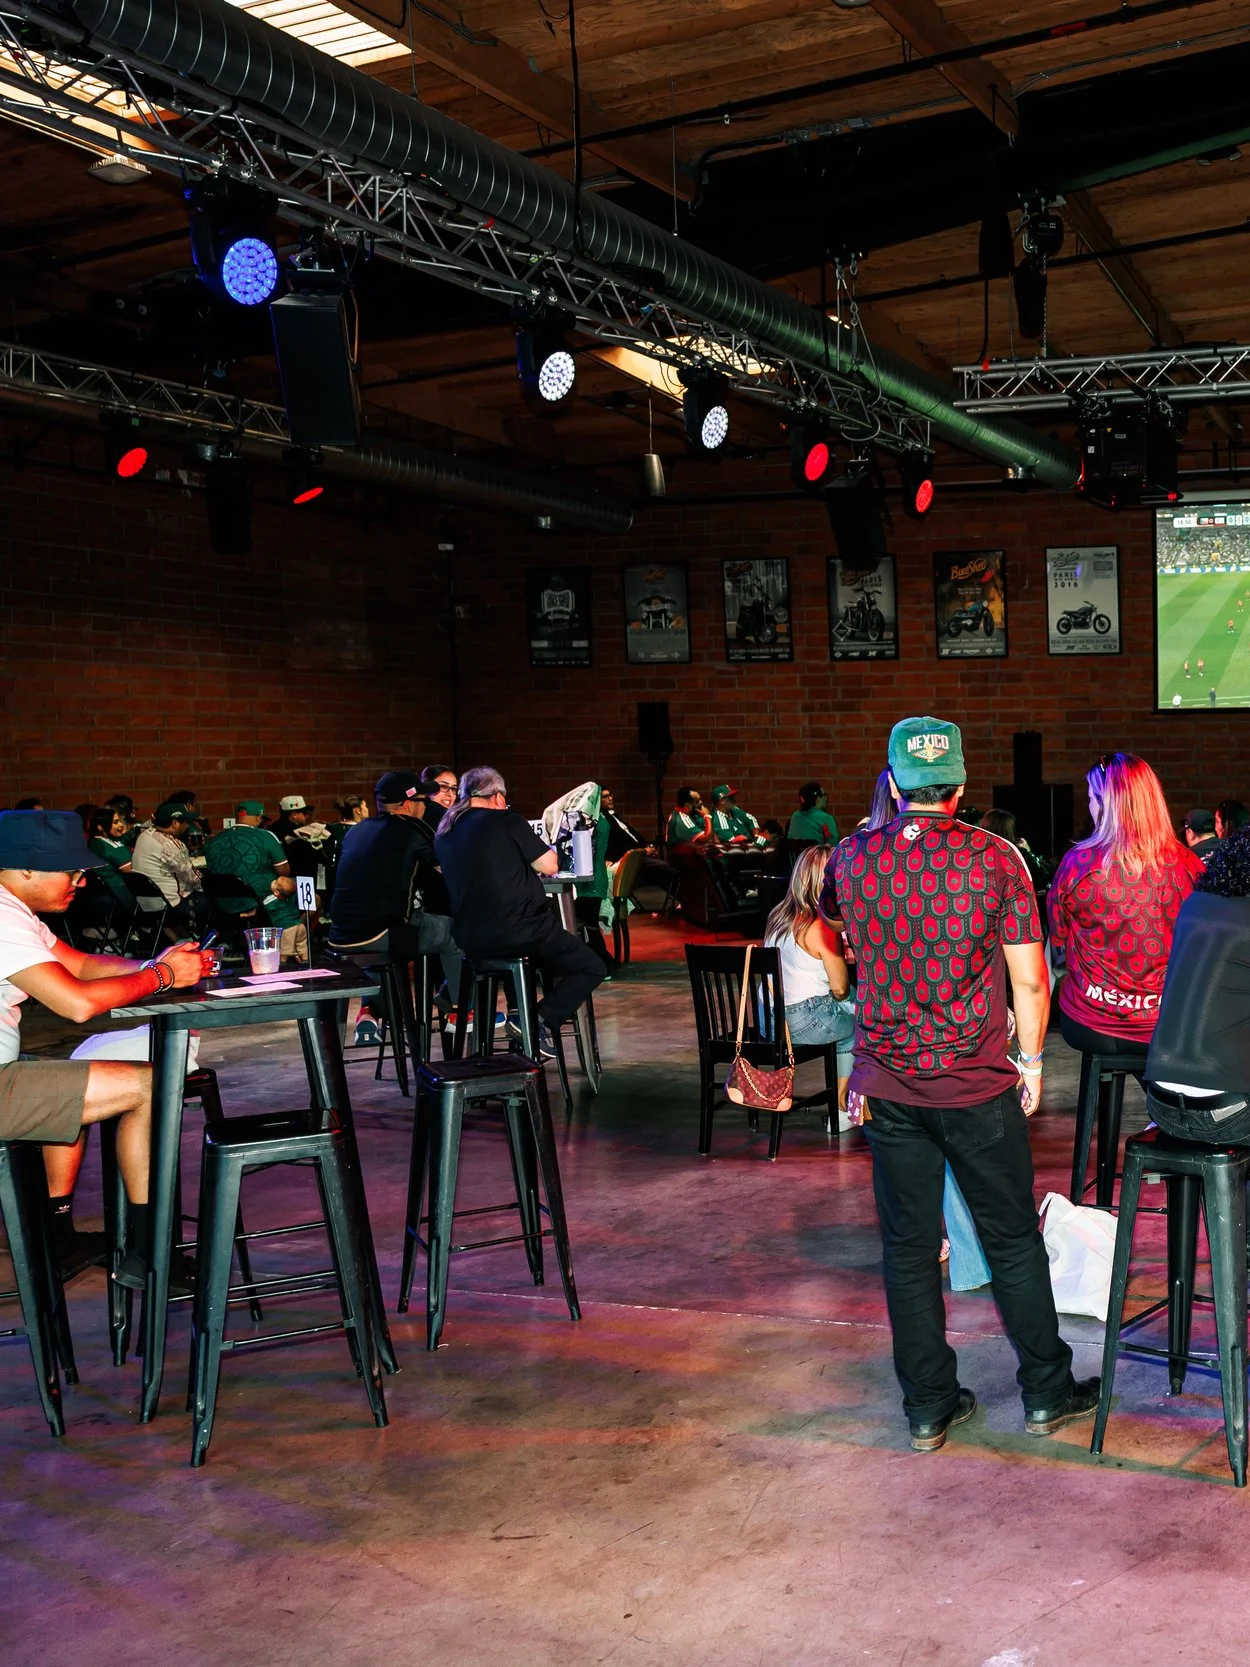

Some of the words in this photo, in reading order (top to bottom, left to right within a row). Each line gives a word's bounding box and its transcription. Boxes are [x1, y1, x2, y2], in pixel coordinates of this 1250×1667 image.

[907, 734, 949, 752] MEXICO
[300, 882, 312, 905] 18
[1085, 984, 1162, 1009] MÉXIC
